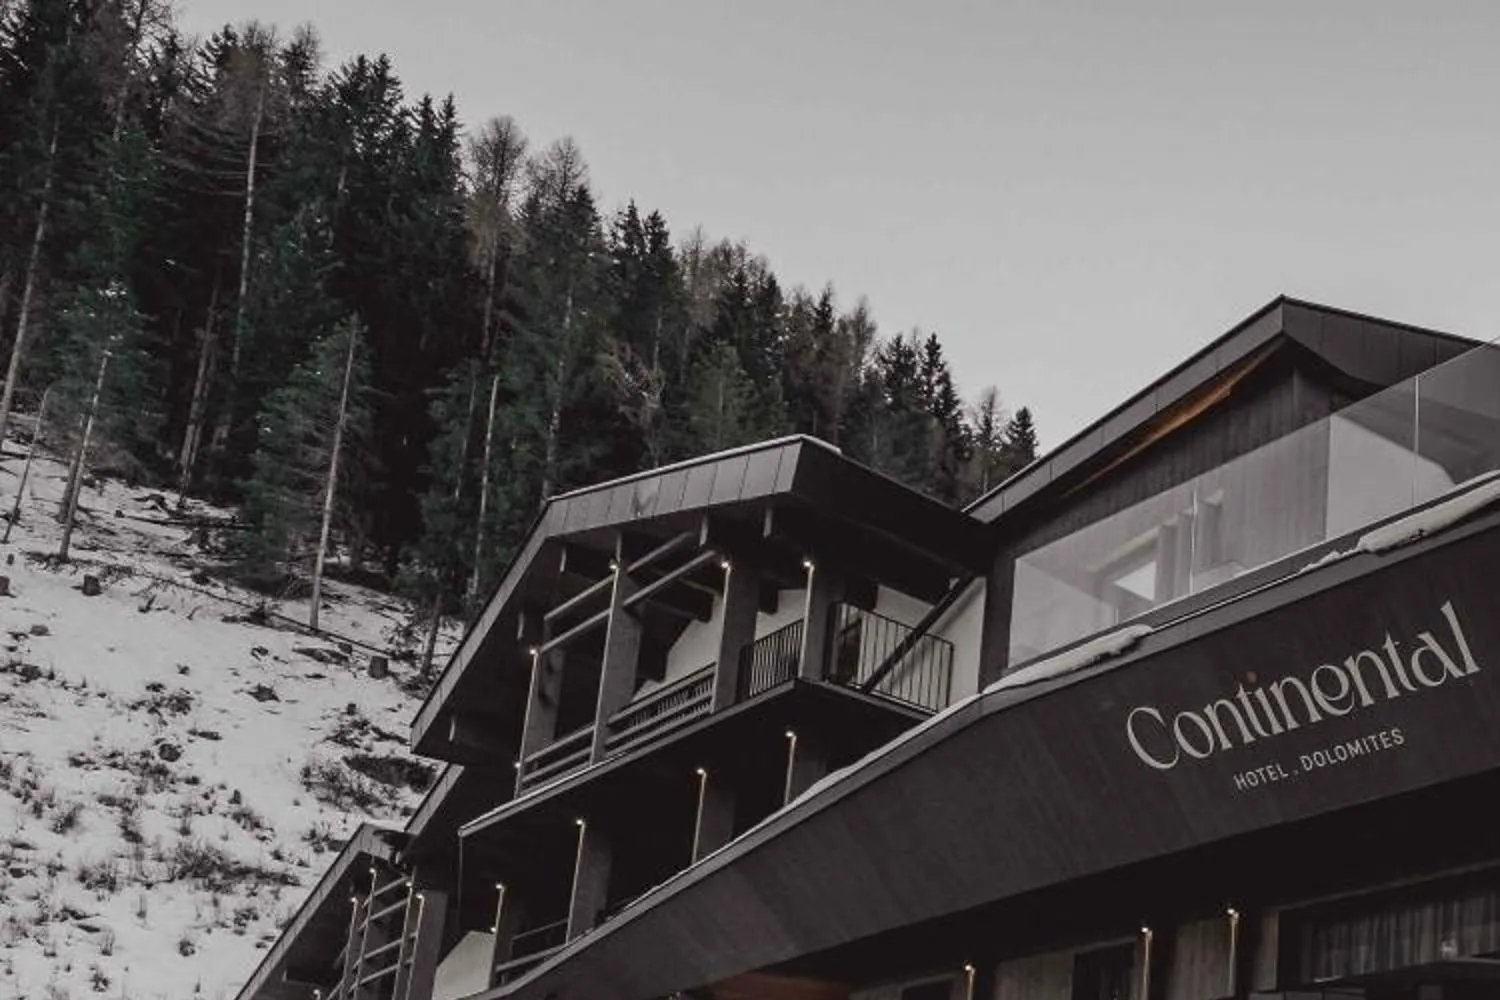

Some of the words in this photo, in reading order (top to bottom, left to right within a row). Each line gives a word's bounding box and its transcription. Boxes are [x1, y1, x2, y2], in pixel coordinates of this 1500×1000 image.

[1126, 600, 1481, 770] Continental
[1233, 763, 1289, 790] HOTEL
[1300, 728, 1405, 771] DOLOMITES
